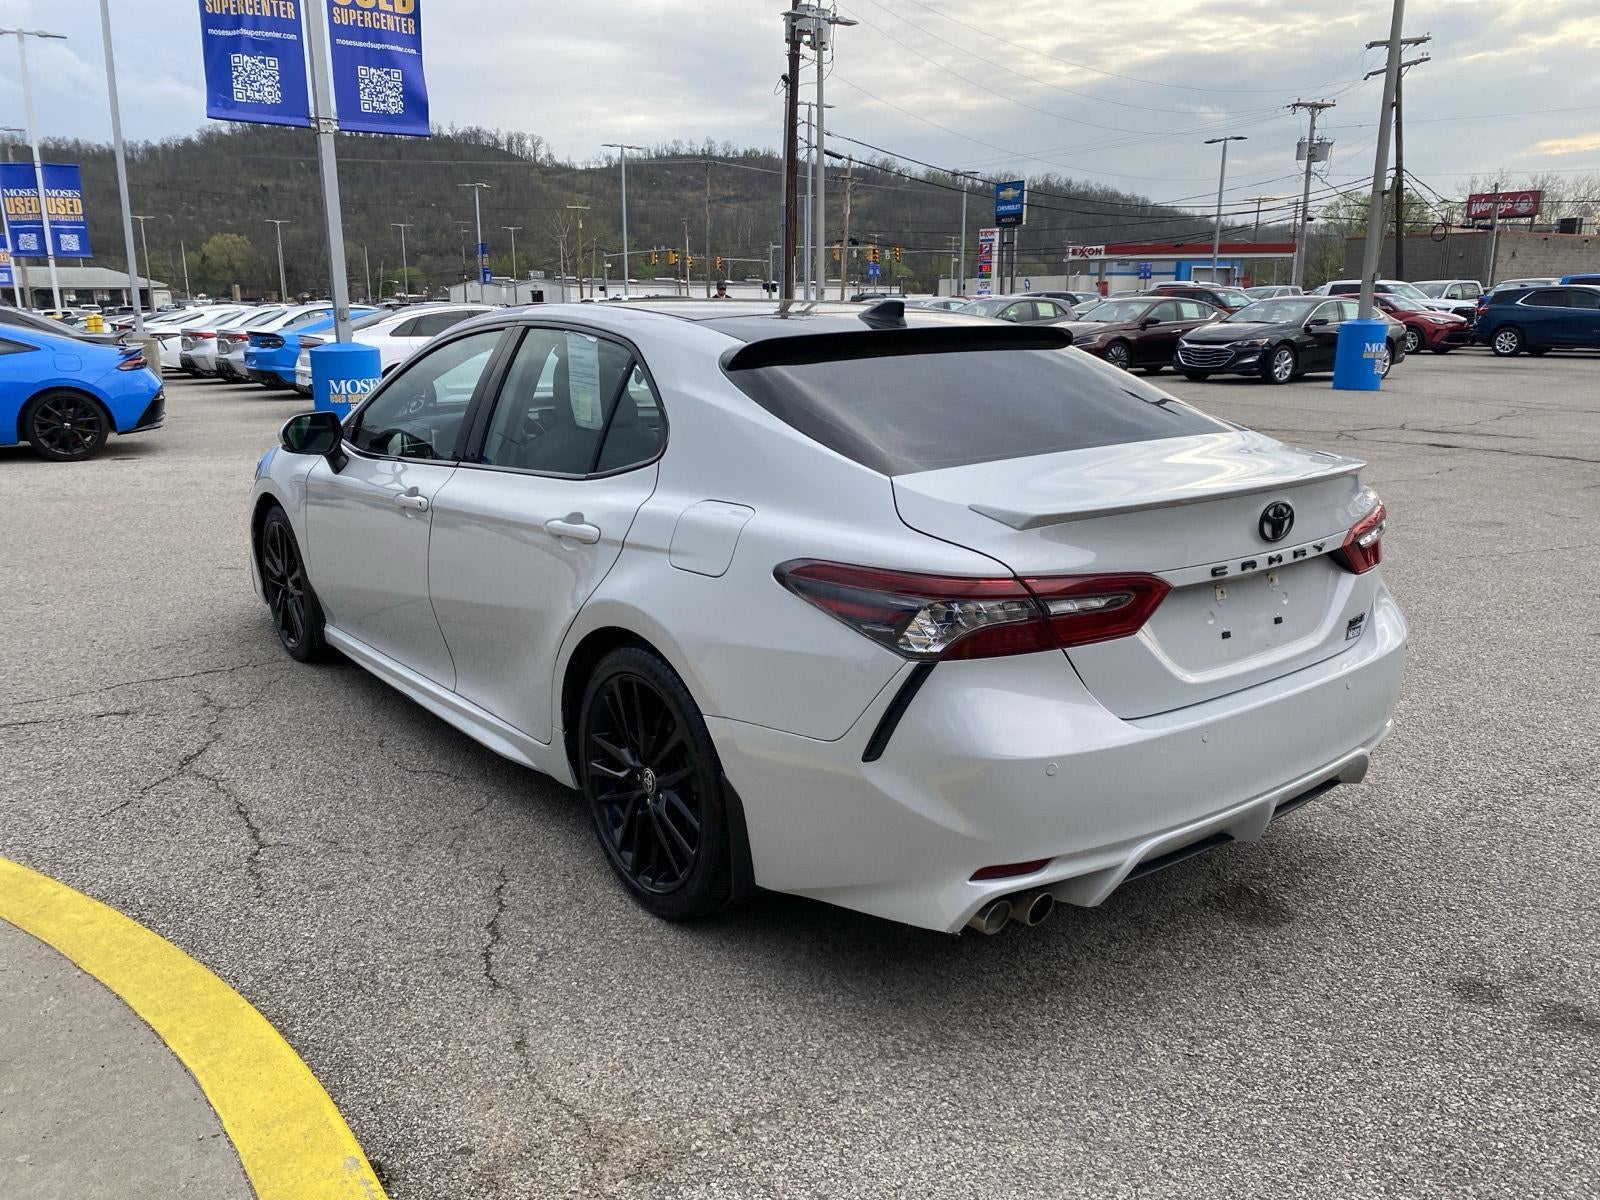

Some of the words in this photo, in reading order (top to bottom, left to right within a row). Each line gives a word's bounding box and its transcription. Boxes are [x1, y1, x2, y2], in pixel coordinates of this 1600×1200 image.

[205, 0, 296, 19] SUPERCENTER
[333, 6, 415, 35] SUPERCENTER
[207, 28, 297, 40] mosesusedsupercenter.com
[335, 38, 417, 55] mosesusedsupercenter.com
[3, 188, 38, 197] MOSES
[45, 188, 80, 198] MOSES
[4, 196, 40, 214] USED
[46, 197, 83, 215] USED
[1471, 195, 1514, 215] Weny's
[1071, 246, 1103, 258] EXXON
[1210, 542, 1326, 577] CAMRY
